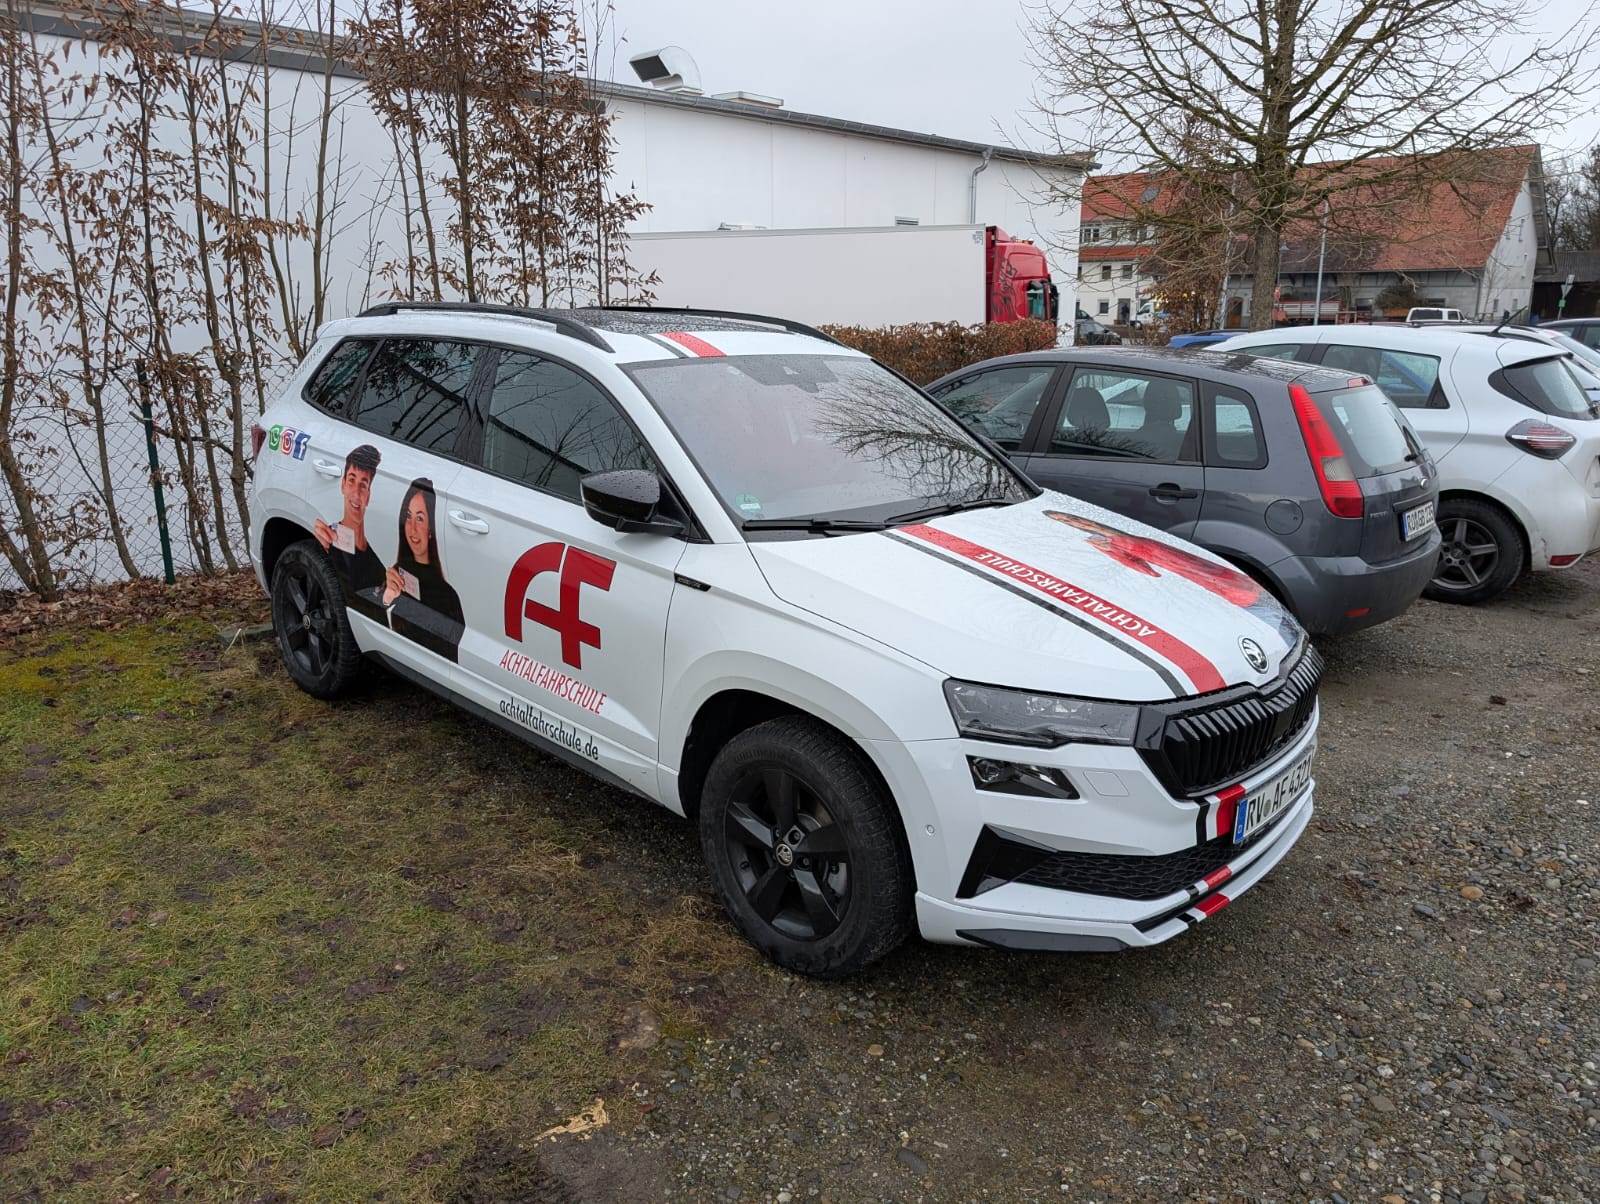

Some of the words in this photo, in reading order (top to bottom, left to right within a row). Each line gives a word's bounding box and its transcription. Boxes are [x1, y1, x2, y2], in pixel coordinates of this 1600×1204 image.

[975, 552, 1157, 637] ACHTALFAHRSCHULE
[500, 649, 608, 715] ACHTALFAHRSCHULE
[500, 696, 599, 760] achtalfahrschule.de
[1246, 791, 1265, 830] RV
[1272, 775, 1289, 812] AF
